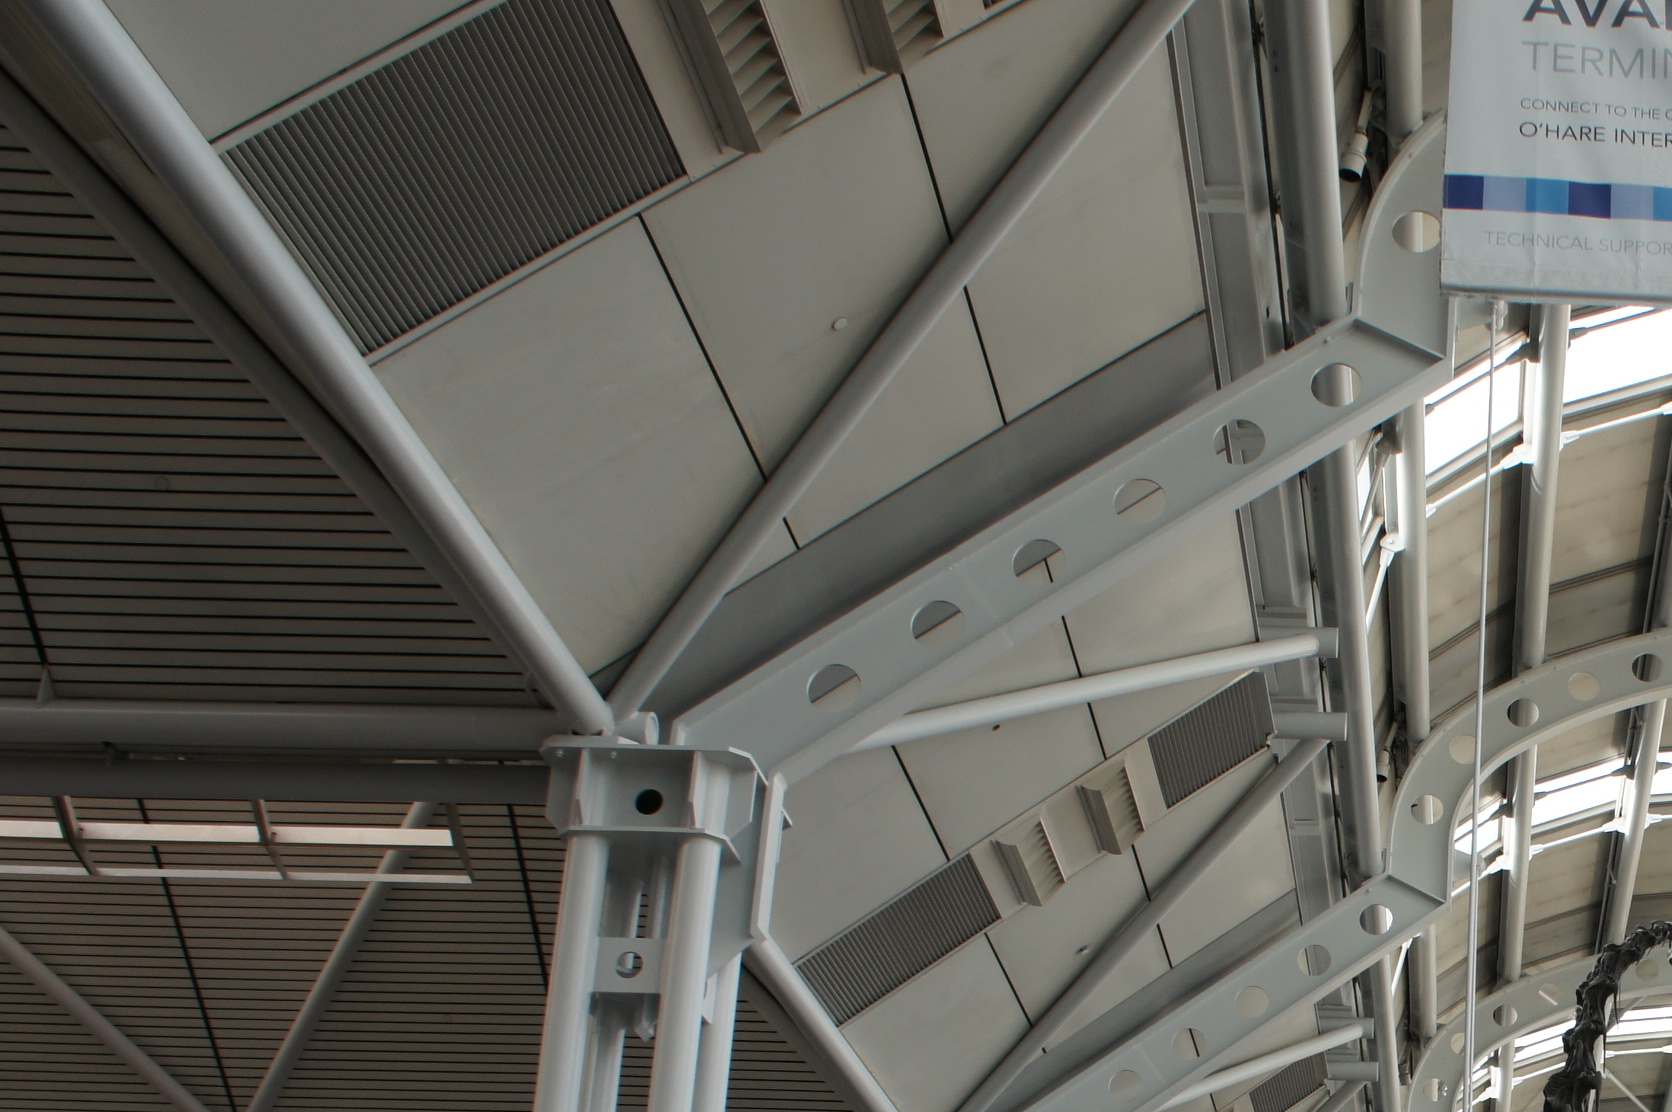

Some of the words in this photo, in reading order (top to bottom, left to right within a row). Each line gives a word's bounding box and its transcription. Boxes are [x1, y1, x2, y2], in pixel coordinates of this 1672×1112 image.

[1519, 98, 1601, 116] CONNECT
[1605, 103, 1628, 118] TO
[1631, 106, 1661, 121] THE
[1518, 121, 1606, 143] O'HARE
[1484, 230, 1593, 253] TECHNICAL
